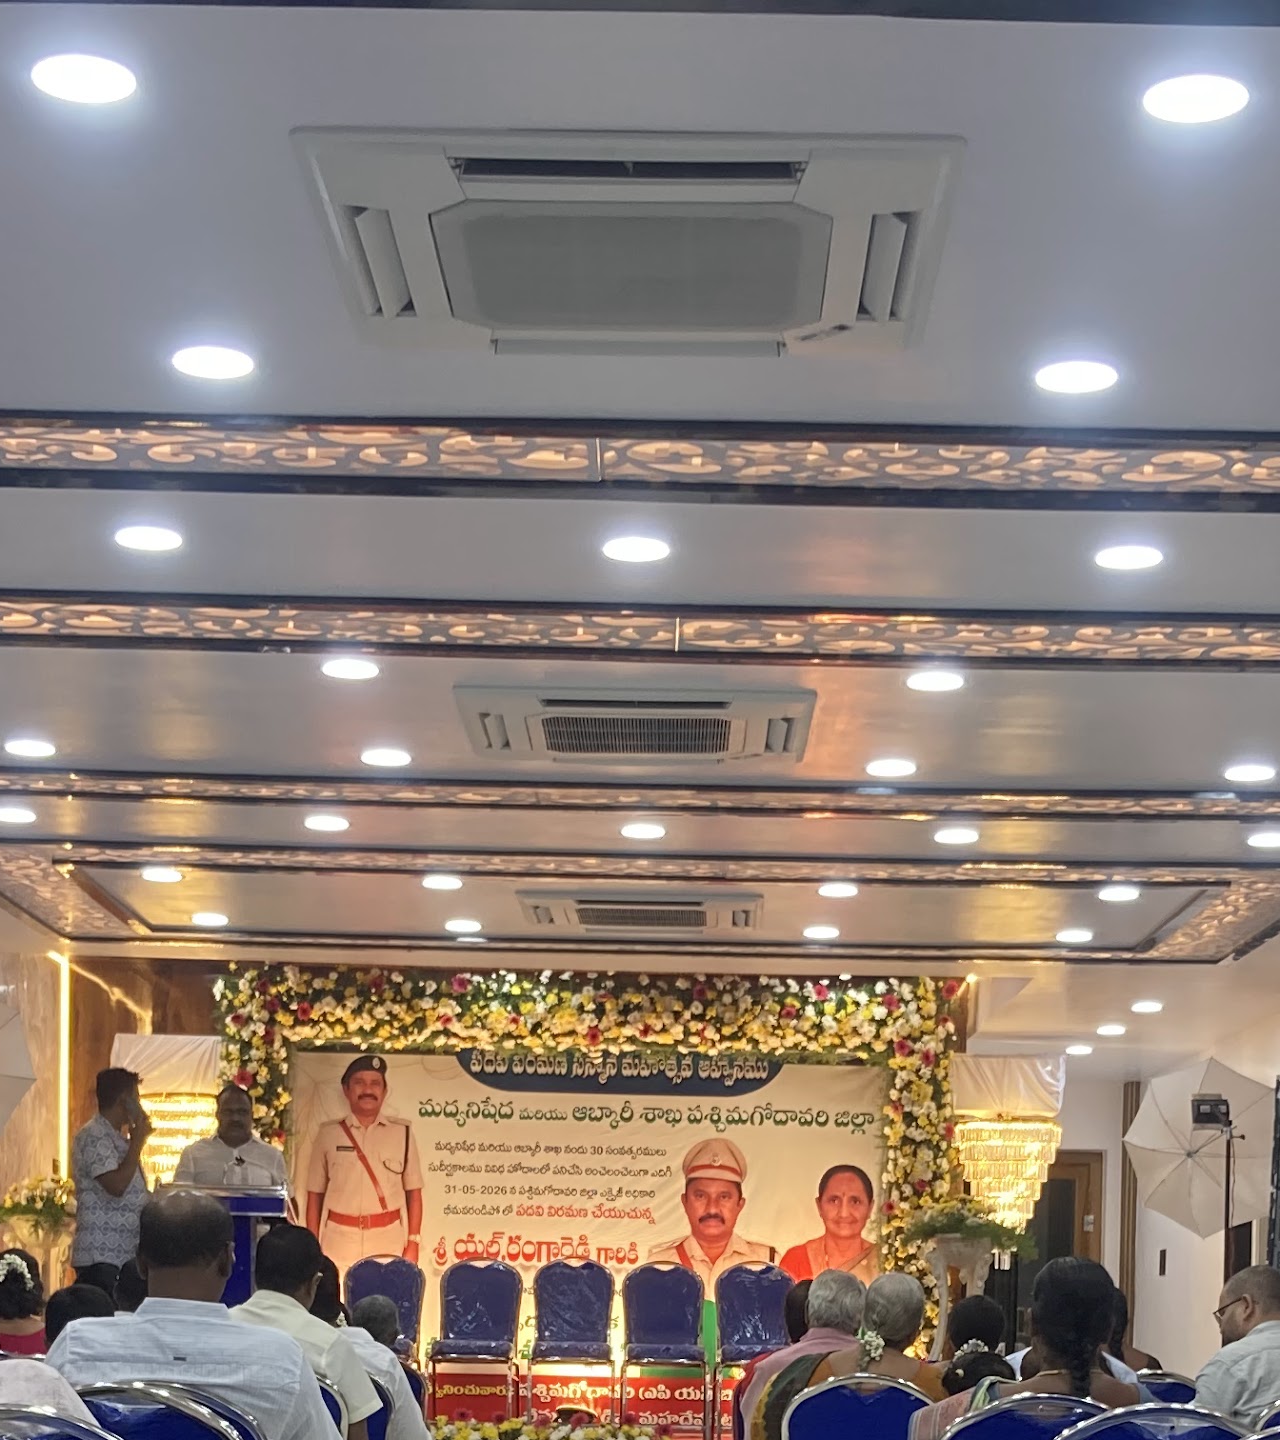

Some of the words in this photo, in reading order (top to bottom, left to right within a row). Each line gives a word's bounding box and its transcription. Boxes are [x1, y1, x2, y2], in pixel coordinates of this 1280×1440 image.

[519, 1108, 567, 1121] మరియు
[572, 1100, 634, 1130] ఆబ్కారీ
[639, 1105, 682, 1128] శాఖ
[687, 1102, 829, 1133] పశ్చిమగోదావరి
[834, 1110, 875, 1135] జిల్లా
[478, 1143, 512, 1153] మరియు
[544, 1146, 562, 1156] శాఖ
[590, 1146, 603, 1155] 30
[444, 1186, 507, 1196] 31-05-2026
[516, 1204, 544, 1218] పదవి
[547, 1205, 588, 1218] విరమణ
[591, 1203, 656, 1225] చేయుచున్న
[433, 1235, 447, 1266] శ్రీ
[596, 1242, 639, 1266] గారికి
